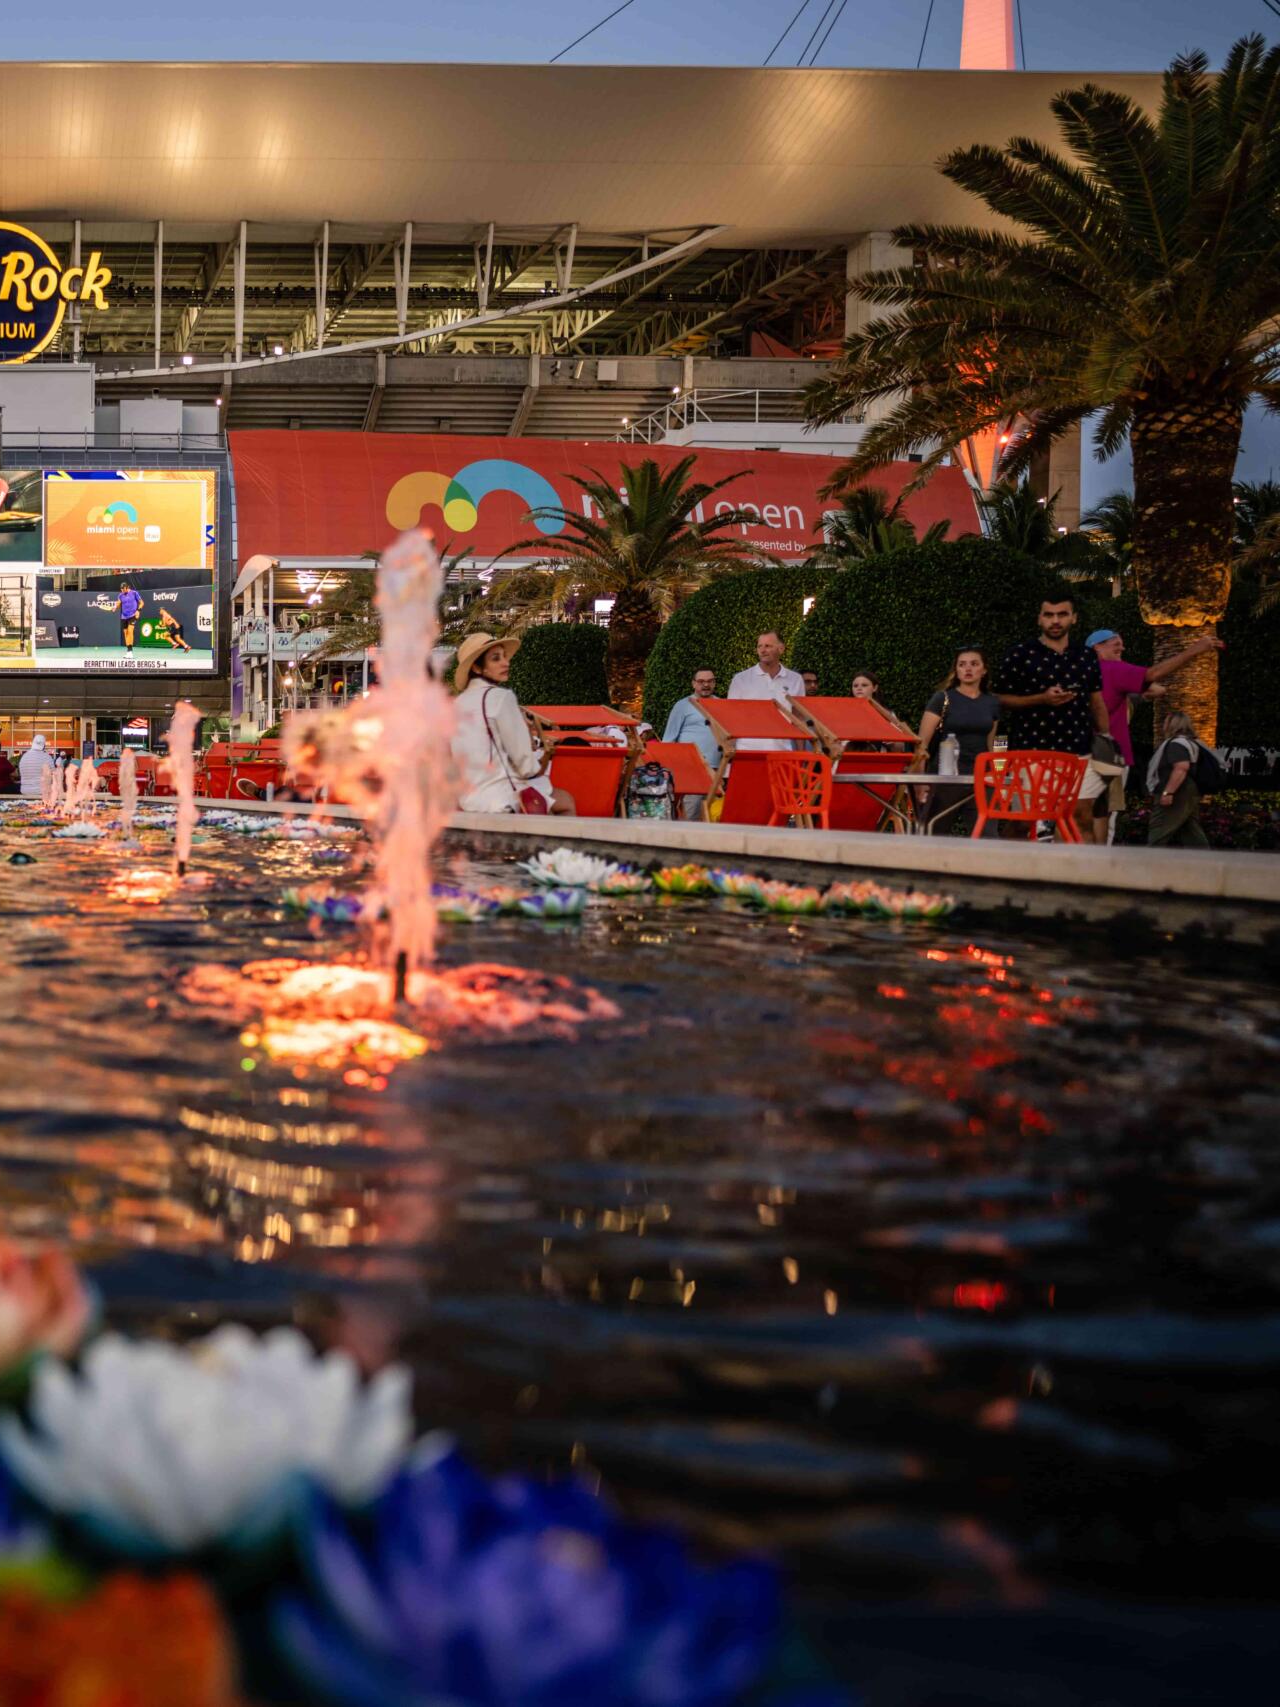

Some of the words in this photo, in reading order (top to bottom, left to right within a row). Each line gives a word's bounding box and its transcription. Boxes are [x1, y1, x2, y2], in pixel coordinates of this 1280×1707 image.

[714, 501, 805, 535] open
[153, 592, 179, 602] betway
[199, 615, 212, 626] ita
[84, 660, 117, 668] BERRETTINI
[118, 660, 135, 668] LEADS
[137, 660, 156, 668] BERGS
[157, 660, 167, 668] 5-4
